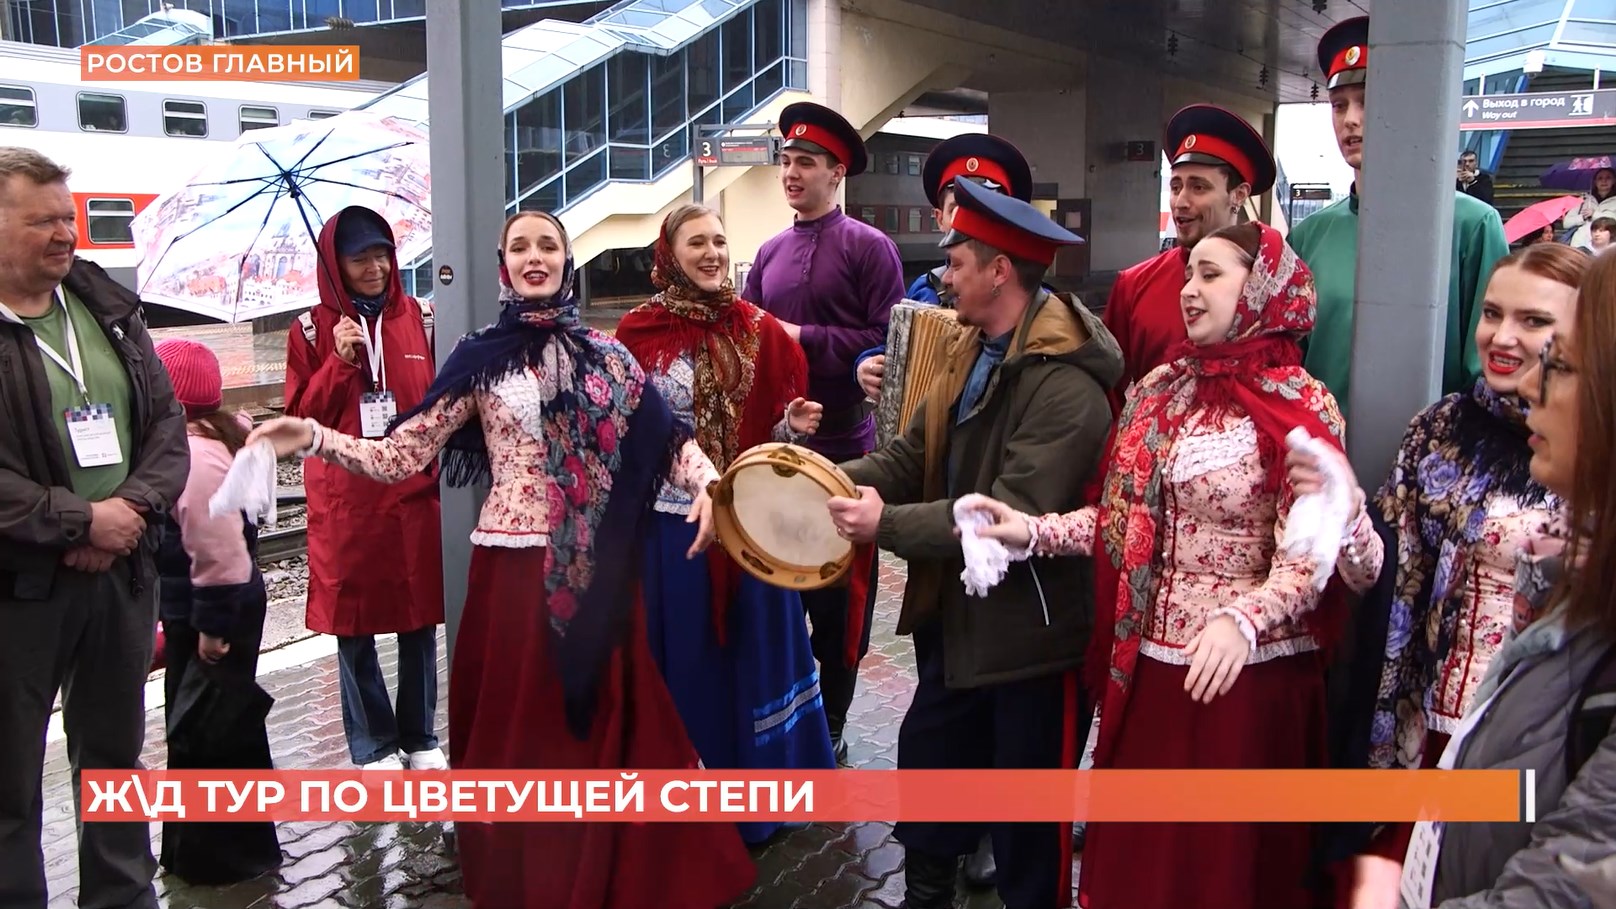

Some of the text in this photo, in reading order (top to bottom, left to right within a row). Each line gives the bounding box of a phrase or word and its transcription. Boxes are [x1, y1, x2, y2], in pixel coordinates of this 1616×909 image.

[1482, 97, 1565, 109] Выход в город
[1481, 111, 1517, 120] Way out
[702, 141, 712, 157] 3
[1136, 143, 1145, 156] 3
